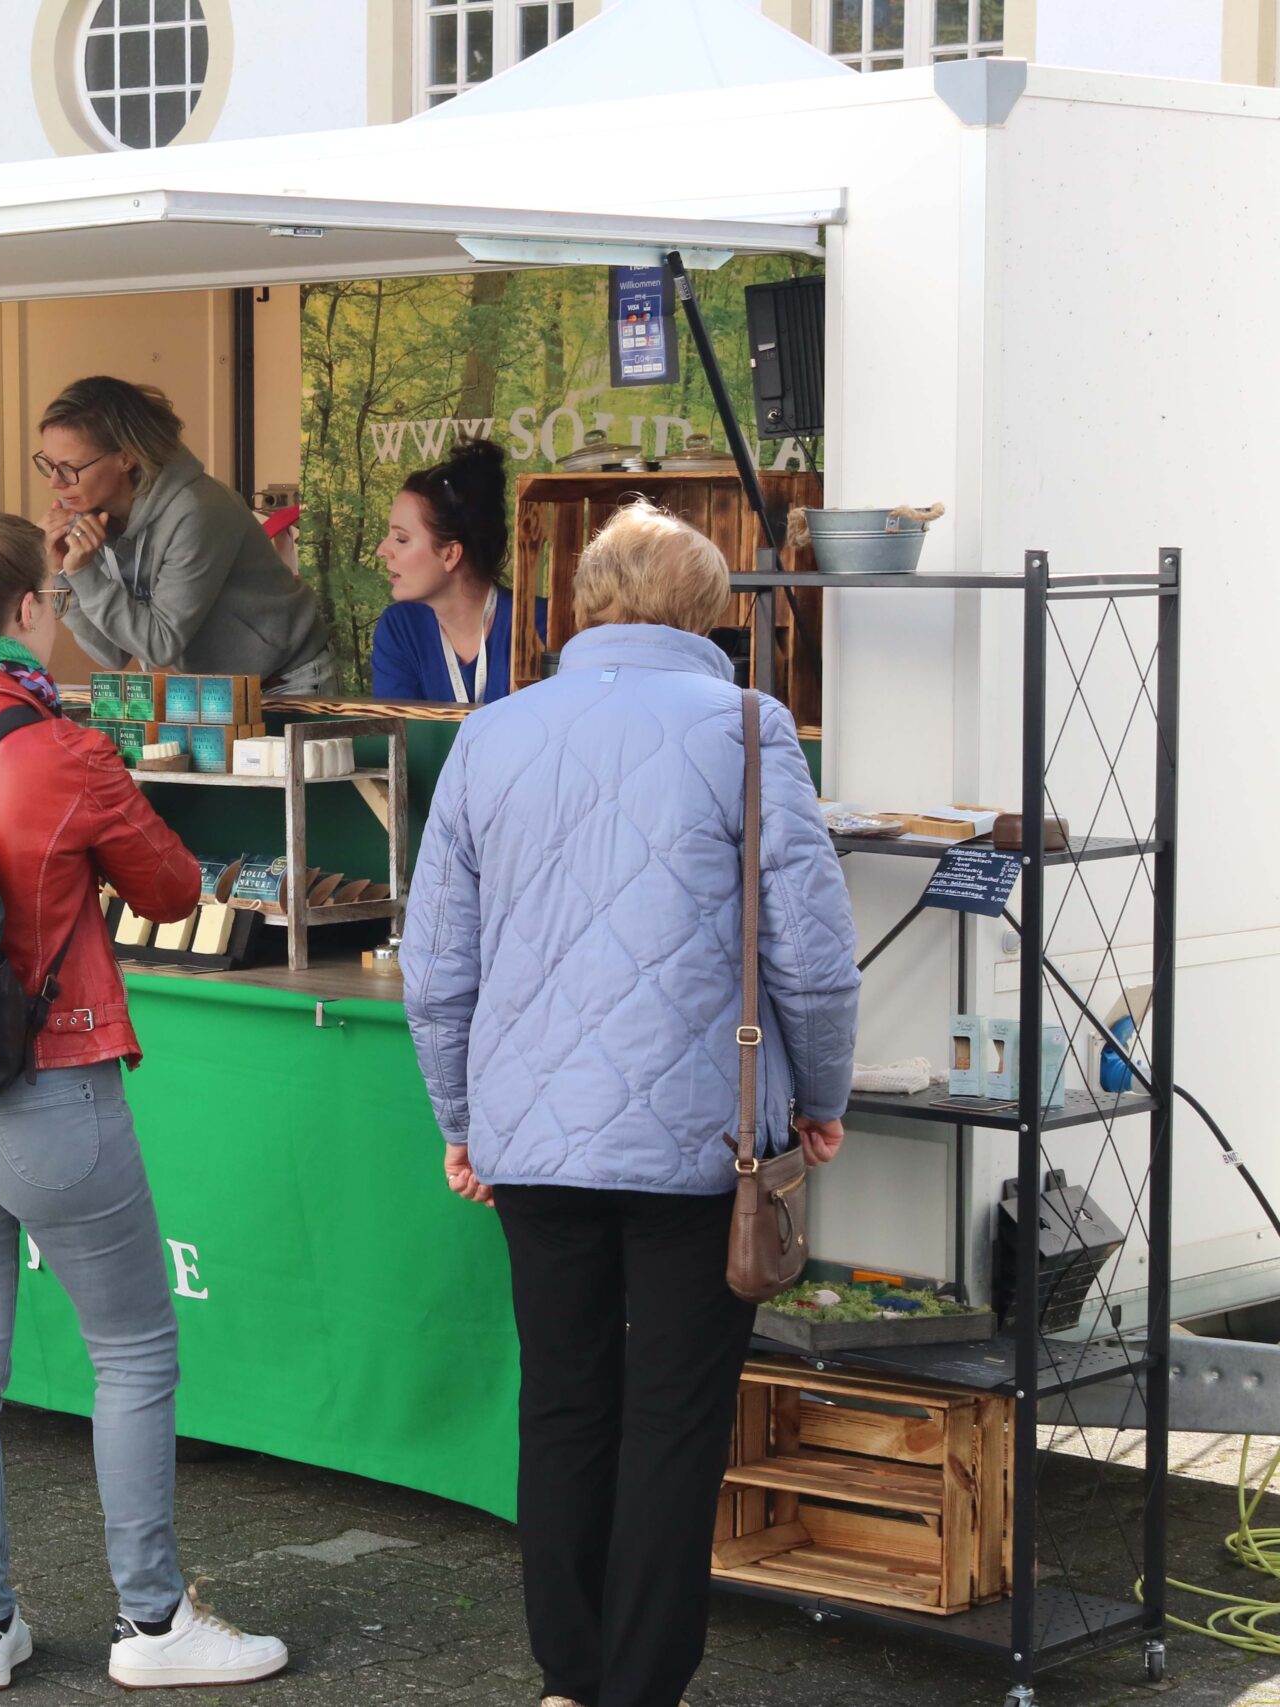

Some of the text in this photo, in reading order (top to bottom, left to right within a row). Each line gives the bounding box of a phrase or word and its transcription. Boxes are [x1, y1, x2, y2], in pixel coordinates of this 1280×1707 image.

[620, 280, 660, 290] Willkommen
[241, 870, 267, 878] SOLID
[239, 880, 272, 888] NATURE
